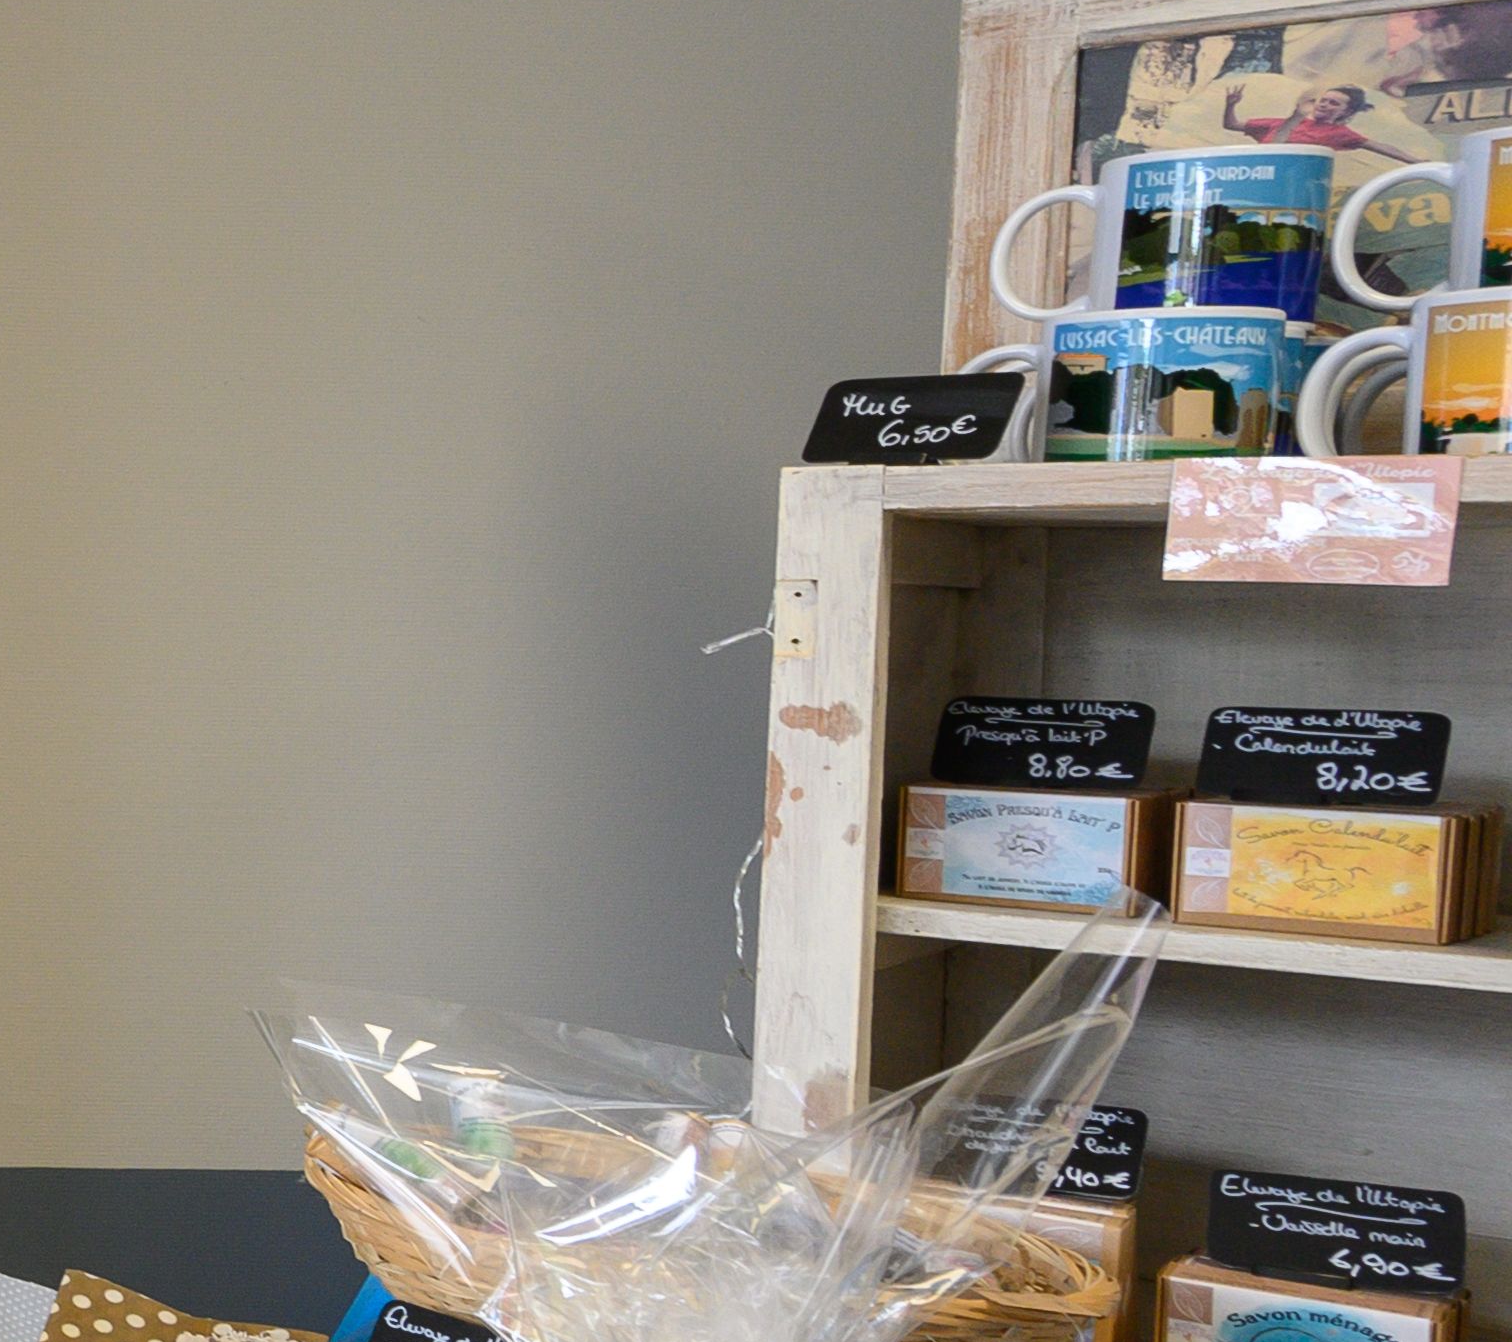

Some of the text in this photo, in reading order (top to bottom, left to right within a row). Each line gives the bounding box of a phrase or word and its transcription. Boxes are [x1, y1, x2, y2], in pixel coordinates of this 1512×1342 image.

[1059, 324, 1267, 352] LUSSAC-LES-CHÂTEAUX
[877, 413, 980, 450] 6,50€
[1028, 754, 1134, 781] 8,80€
[1315, 761, 1432, 793] 8,20€
[1327, 1249, 1455, 1282] 6,90€
[1227, 1307, 1311, 1328] Savon
